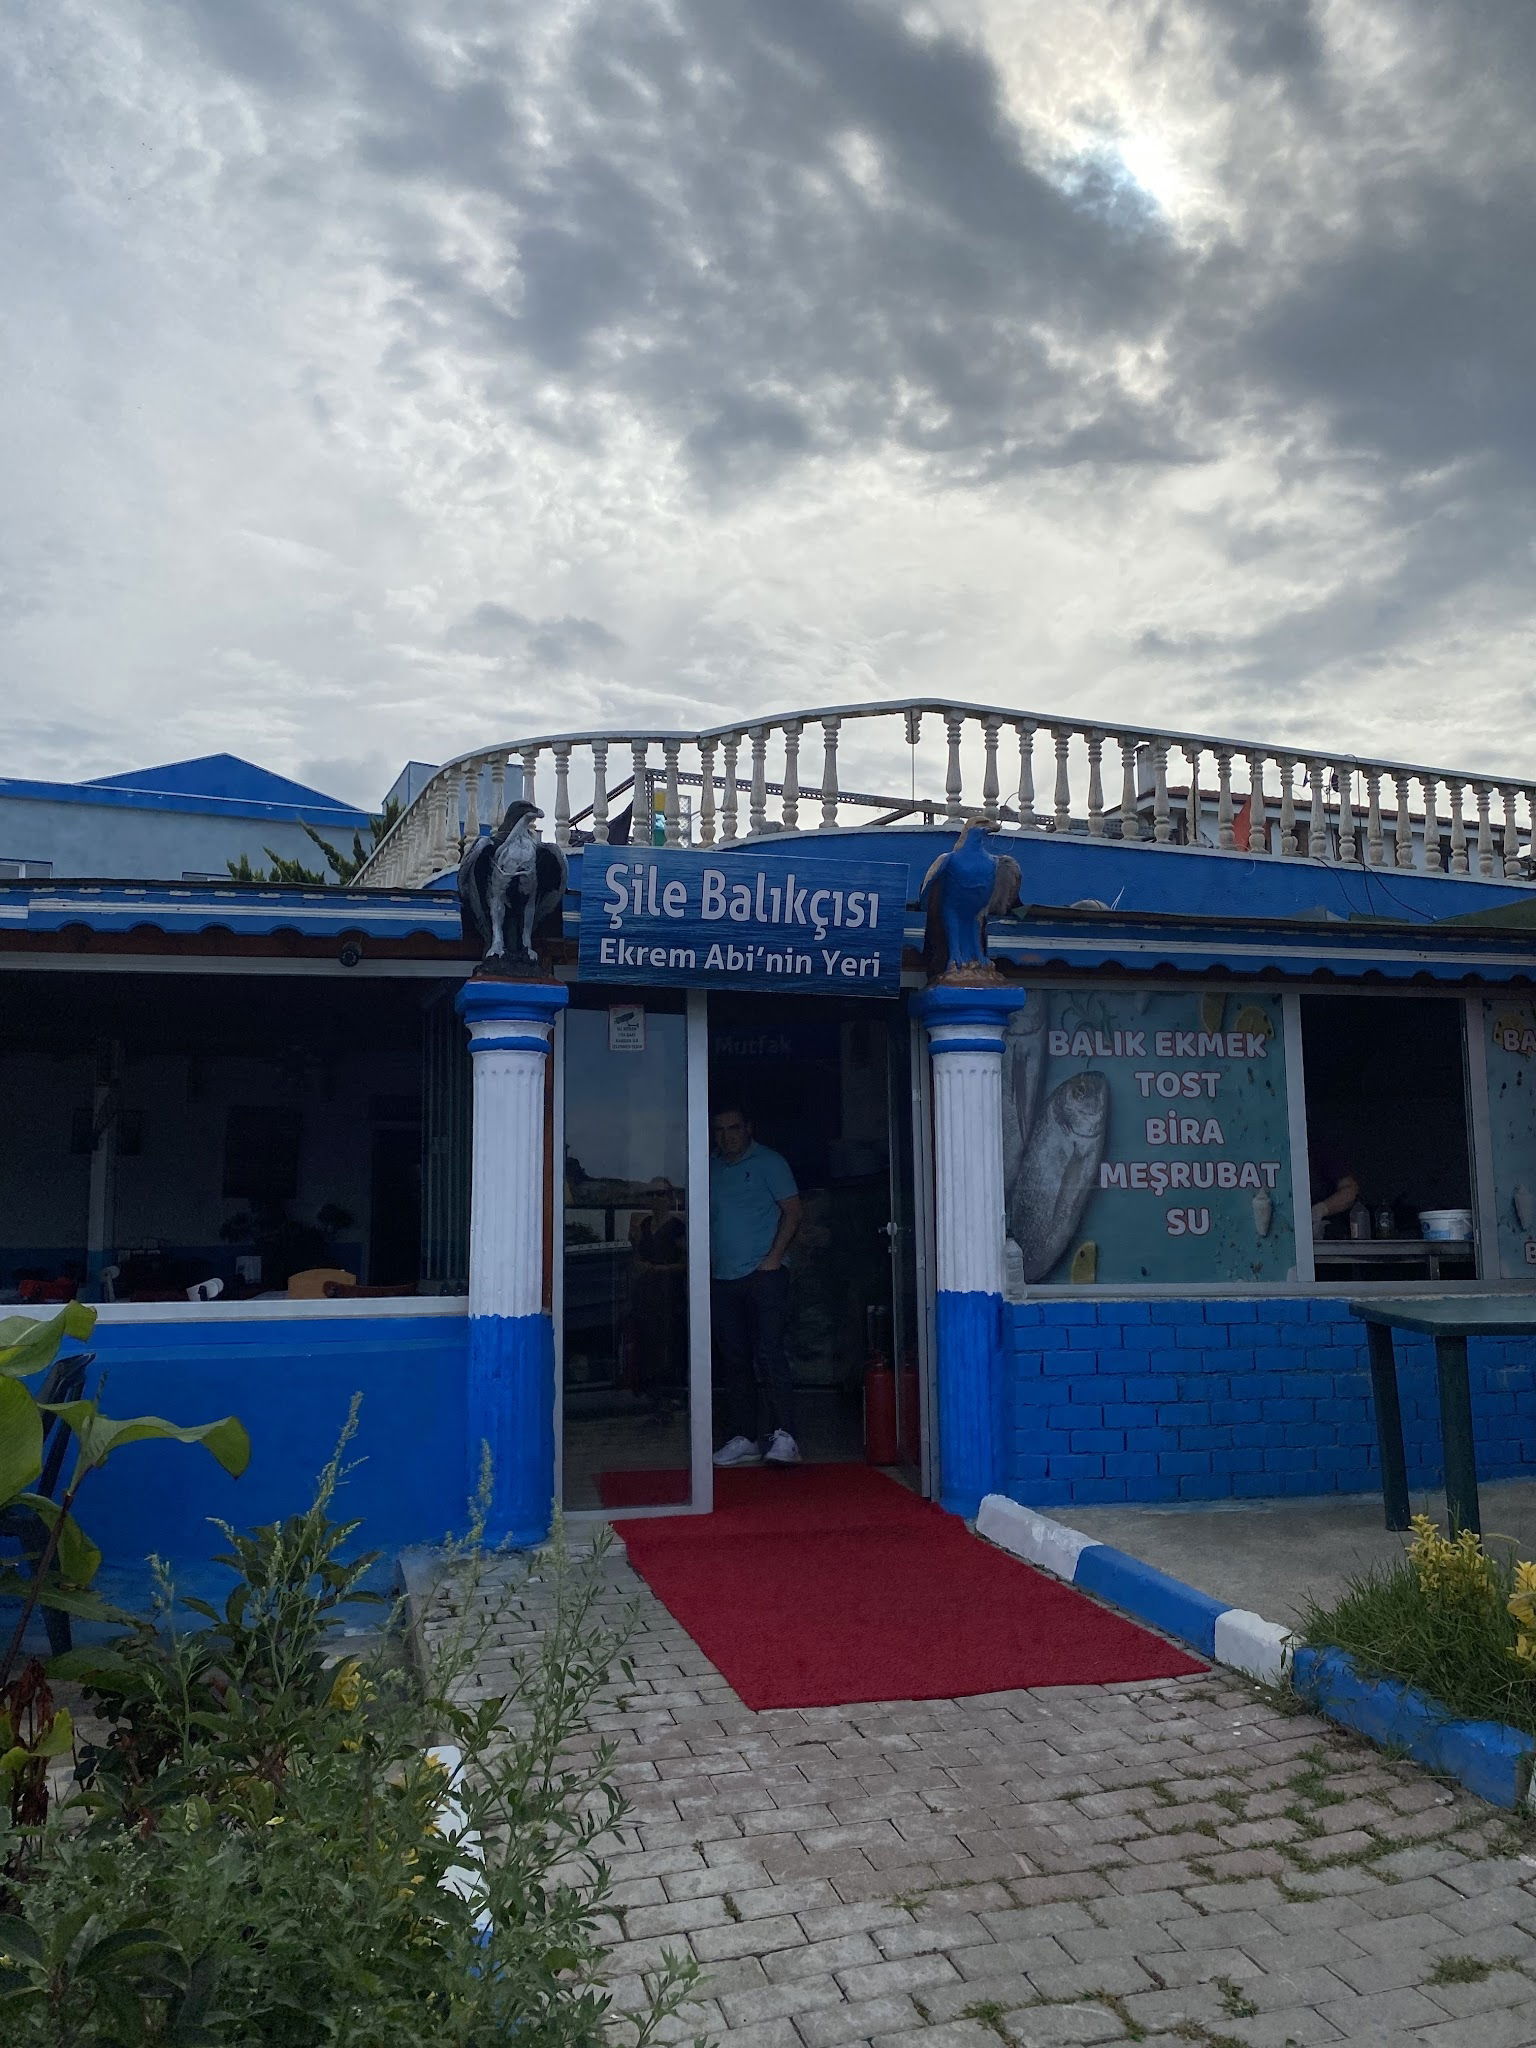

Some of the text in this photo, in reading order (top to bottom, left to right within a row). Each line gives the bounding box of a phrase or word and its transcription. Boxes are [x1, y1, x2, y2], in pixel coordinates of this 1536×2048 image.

[604, 863, 879, 941] Şile Balıkçısı
[600, 937, 880, 978] Ekrem Abi'nin Yeri
[1049, 1030, 1268, 1059] BALIK EKMEK
[1134, 1071, 1222, 1099] TOST
[1146, 1109, 1225, 1145] BİRA
[1100, 1161, 1281, 1197] MEŞRUBAT
[1165, 1207, 1211, 1236] SU
